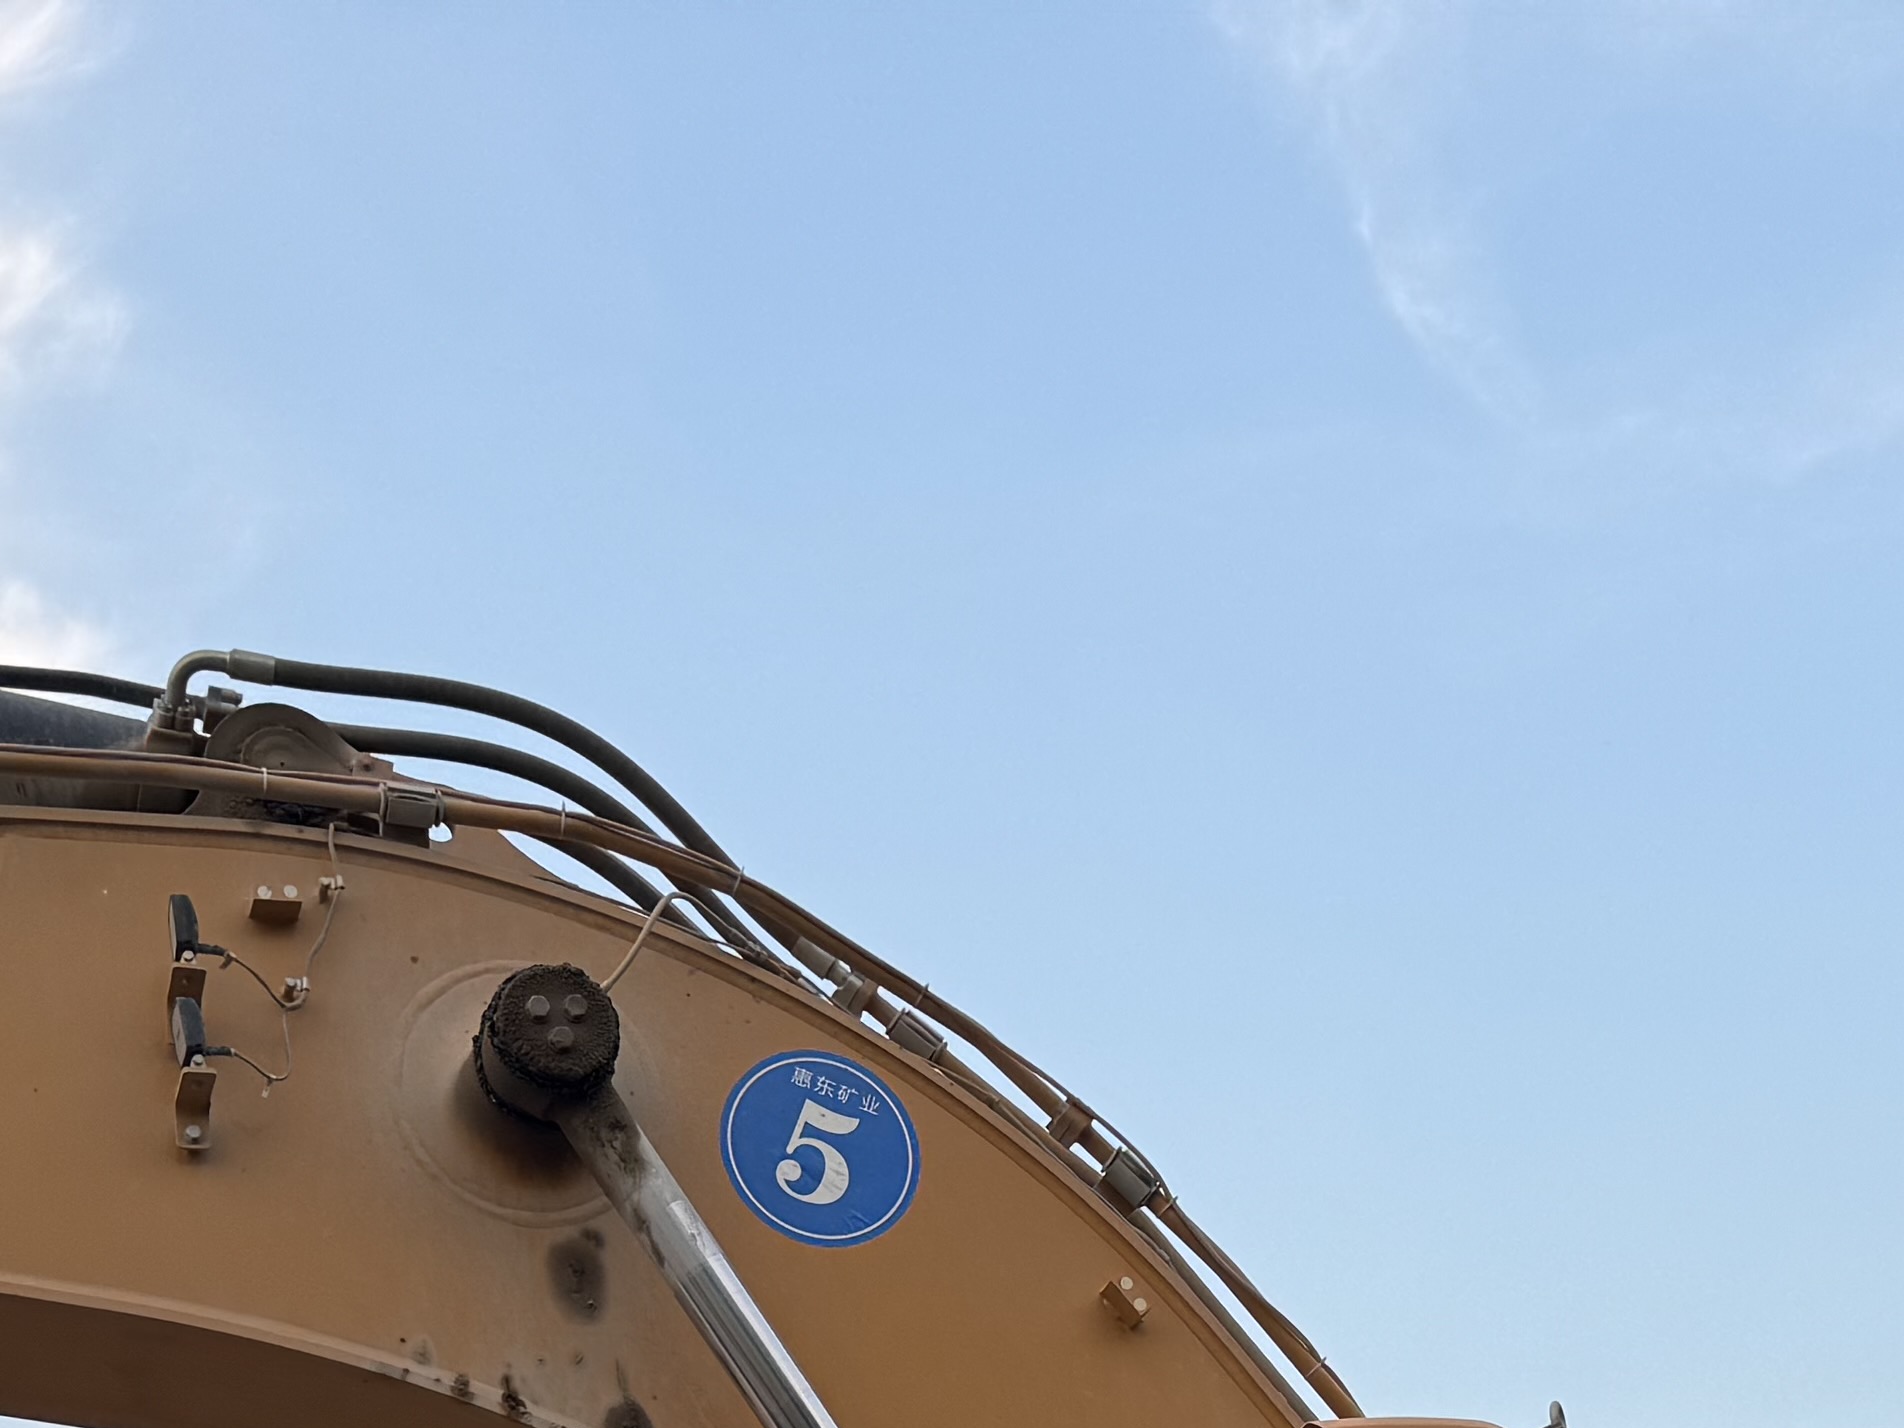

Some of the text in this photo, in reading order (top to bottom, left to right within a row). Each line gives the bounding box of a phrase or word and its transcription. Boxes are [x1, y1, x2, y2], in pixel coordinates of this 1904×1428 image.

[790, 1065, 881, 1116] 惠东矿业
[775, 1098, 860, 1205] 5
